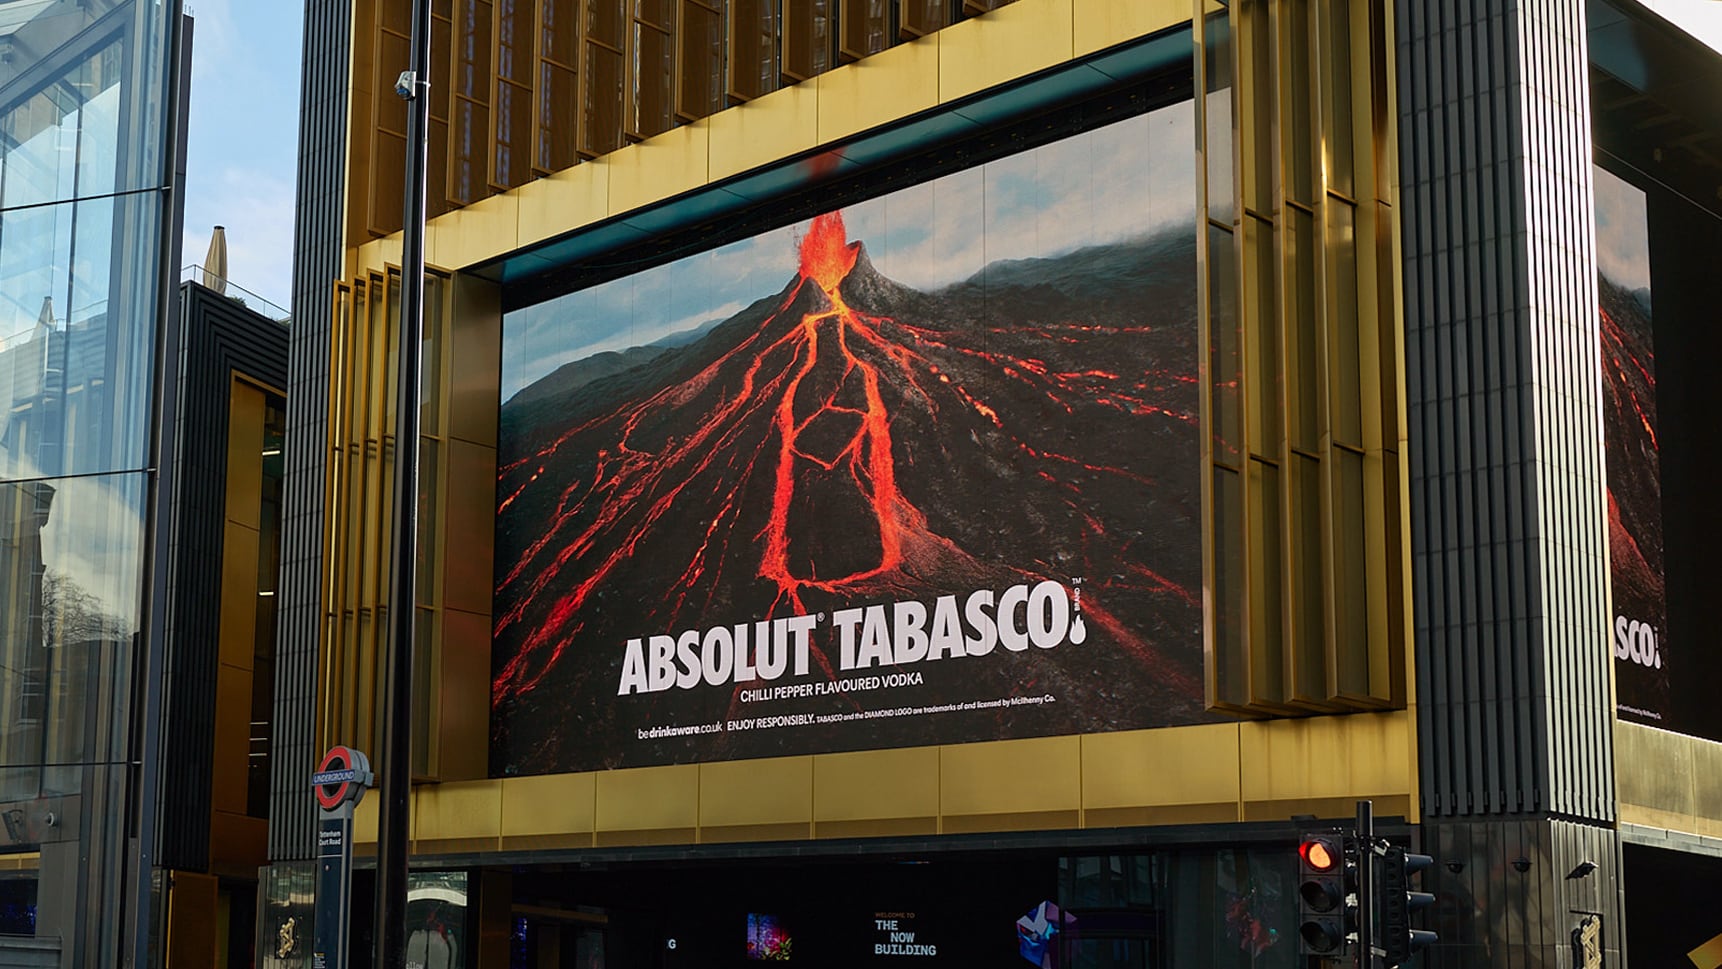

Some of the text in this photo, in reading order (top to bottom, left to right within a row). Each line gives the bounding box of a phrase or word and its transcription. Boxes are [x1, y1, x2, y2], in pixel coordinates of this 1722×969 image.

[833, 580, 1070, 671] TABASCO
[1615, 615, 1655, 667] SCO
[740, 672, 923, 703] CHILLI PEPPER FLAVOURED VODKA
[727, 719, 756, 731] ENJOY
[756, 713, 816, 729] RESPONSIBLY.
[816, 714, 842, 723] TABASCO
[843, 712, 855, 721] and
[855, 711, 864, 719] the
[864, 709, 894, 719] DIAMOND
[895, 707, 912, 716] LOGO
[923, 704, 956, 713] trademarks
[957, 702, 964, 711] of
[964, 700, 976, 709] and
[977, 698, 1001, 708] licensed
[1002, 698, 1011, 707] by
[313, 771, 355, 783] UNDERGROUND
[875, 920, 899, 930] THE
[890, 932, 915, 943] NOW
[874, 943, 937, 956] BUILDING
